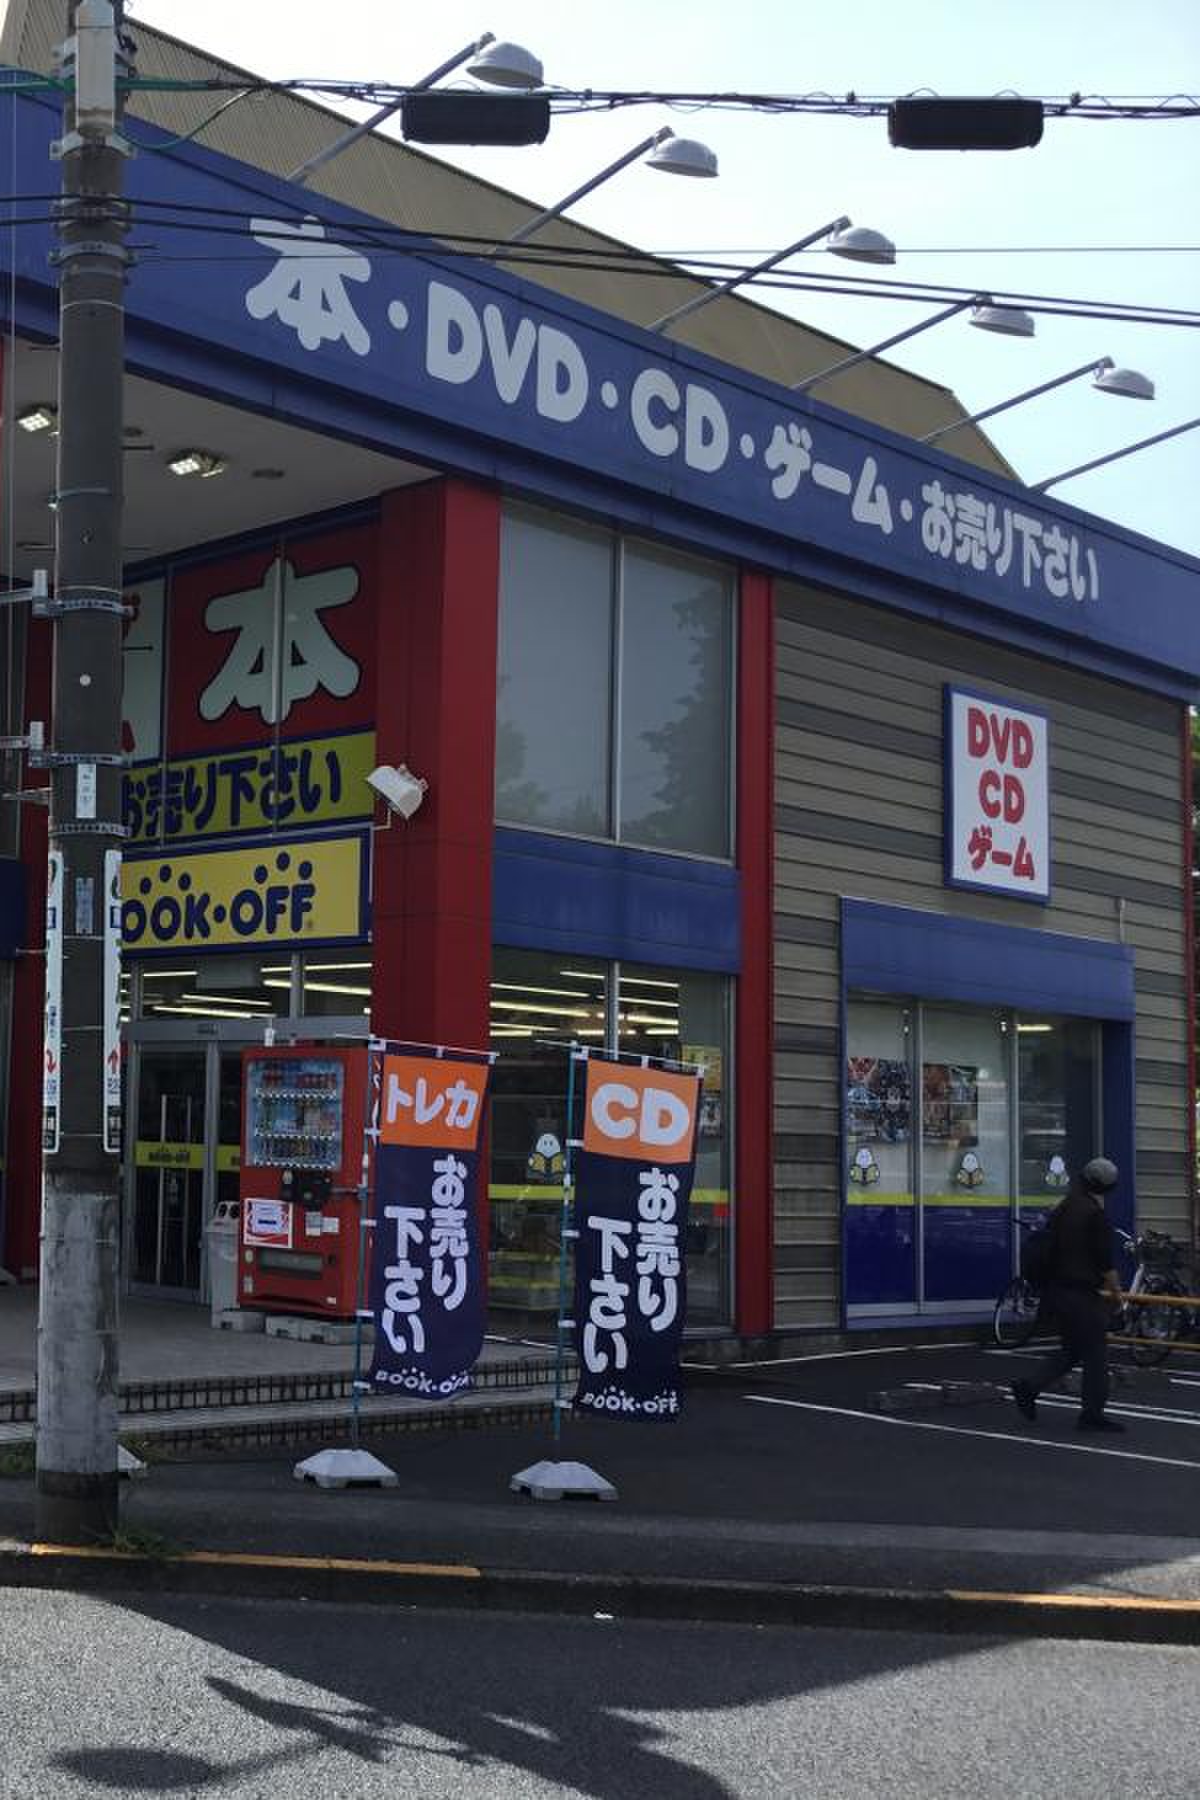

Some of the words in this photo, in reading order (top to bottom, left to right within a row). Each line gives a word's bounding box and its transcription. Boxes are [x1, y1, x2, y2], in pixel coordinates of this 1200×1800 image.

[200, 557, 361, 725] 本
[967, 707, 1034, 768] DVD
[978, 769, 1026, 824] CD
[967, 824, 1036, 881] ゲーム
[385, 1073, 479, 1129] トレカ
[591, 1082, 690, 1146] CD
[382, 1205, 426, 1354] 下さい
[429, 1154, 469, 1311] お売り
[636, 1167, 681, 1332] お売り
[583, 1215, 633, 1374] 下さい
